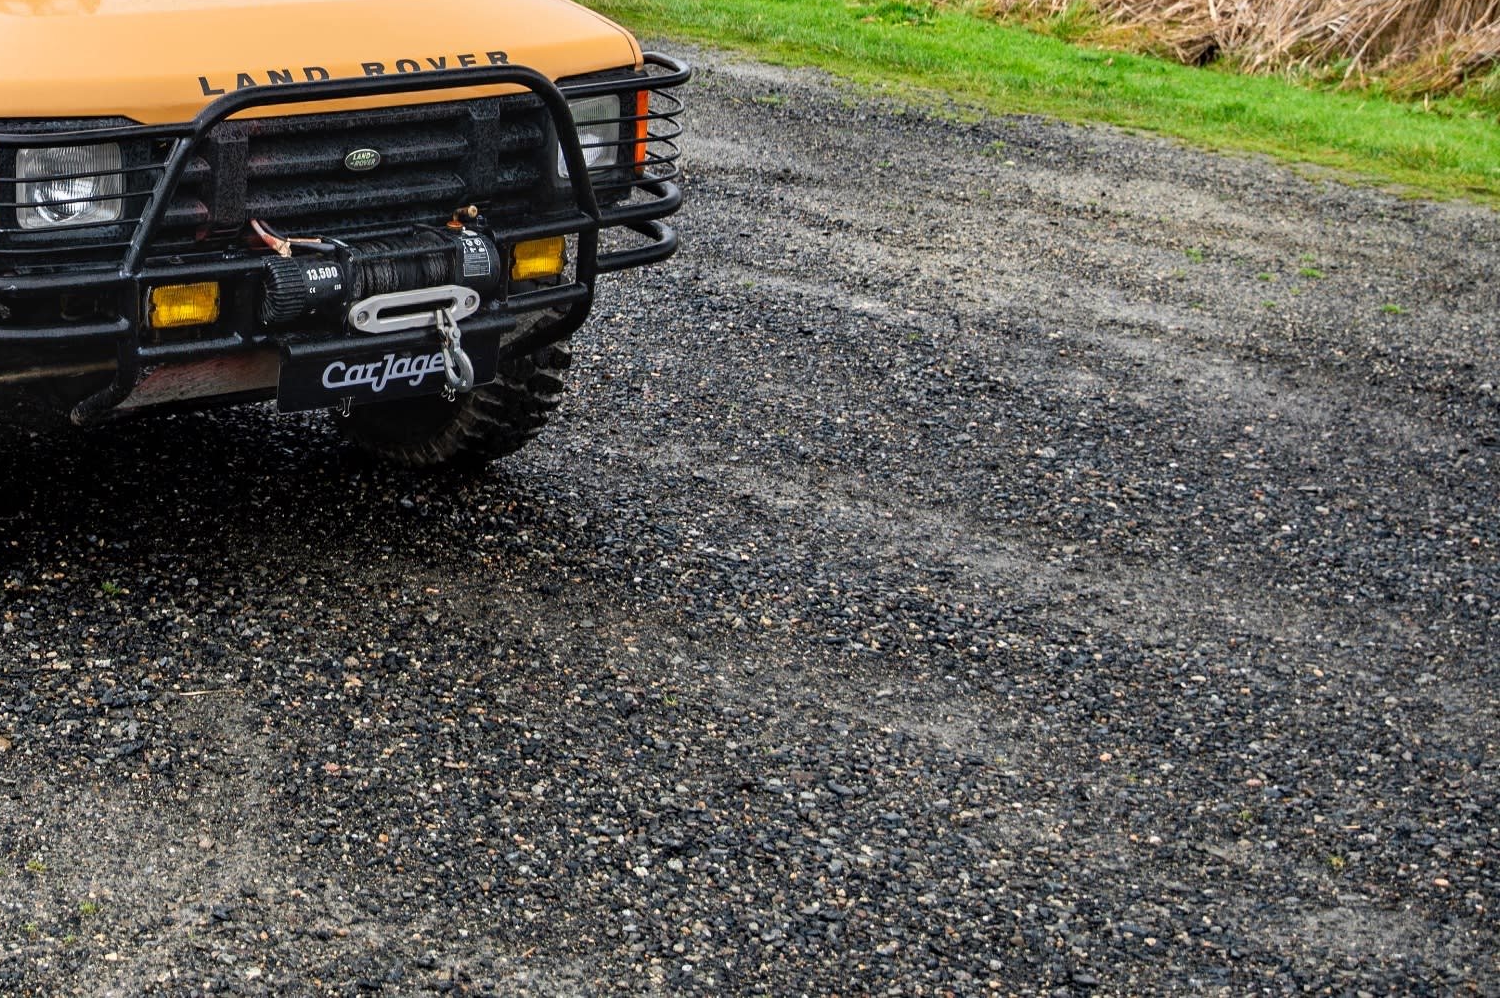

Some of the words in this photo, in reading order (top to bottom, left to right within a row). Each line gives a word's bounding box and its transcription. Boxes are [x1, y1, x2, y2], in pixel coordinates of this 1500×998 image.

[198, 67, 330, 96] LAND
[361, 51, 509, 76] ROVER
[353, 152, 371, 160] LAND
[354, 158, 376, 167] ROVER
[307, 266, 338, 281] 13,500
[322, 352, 447, 393] CarJage
